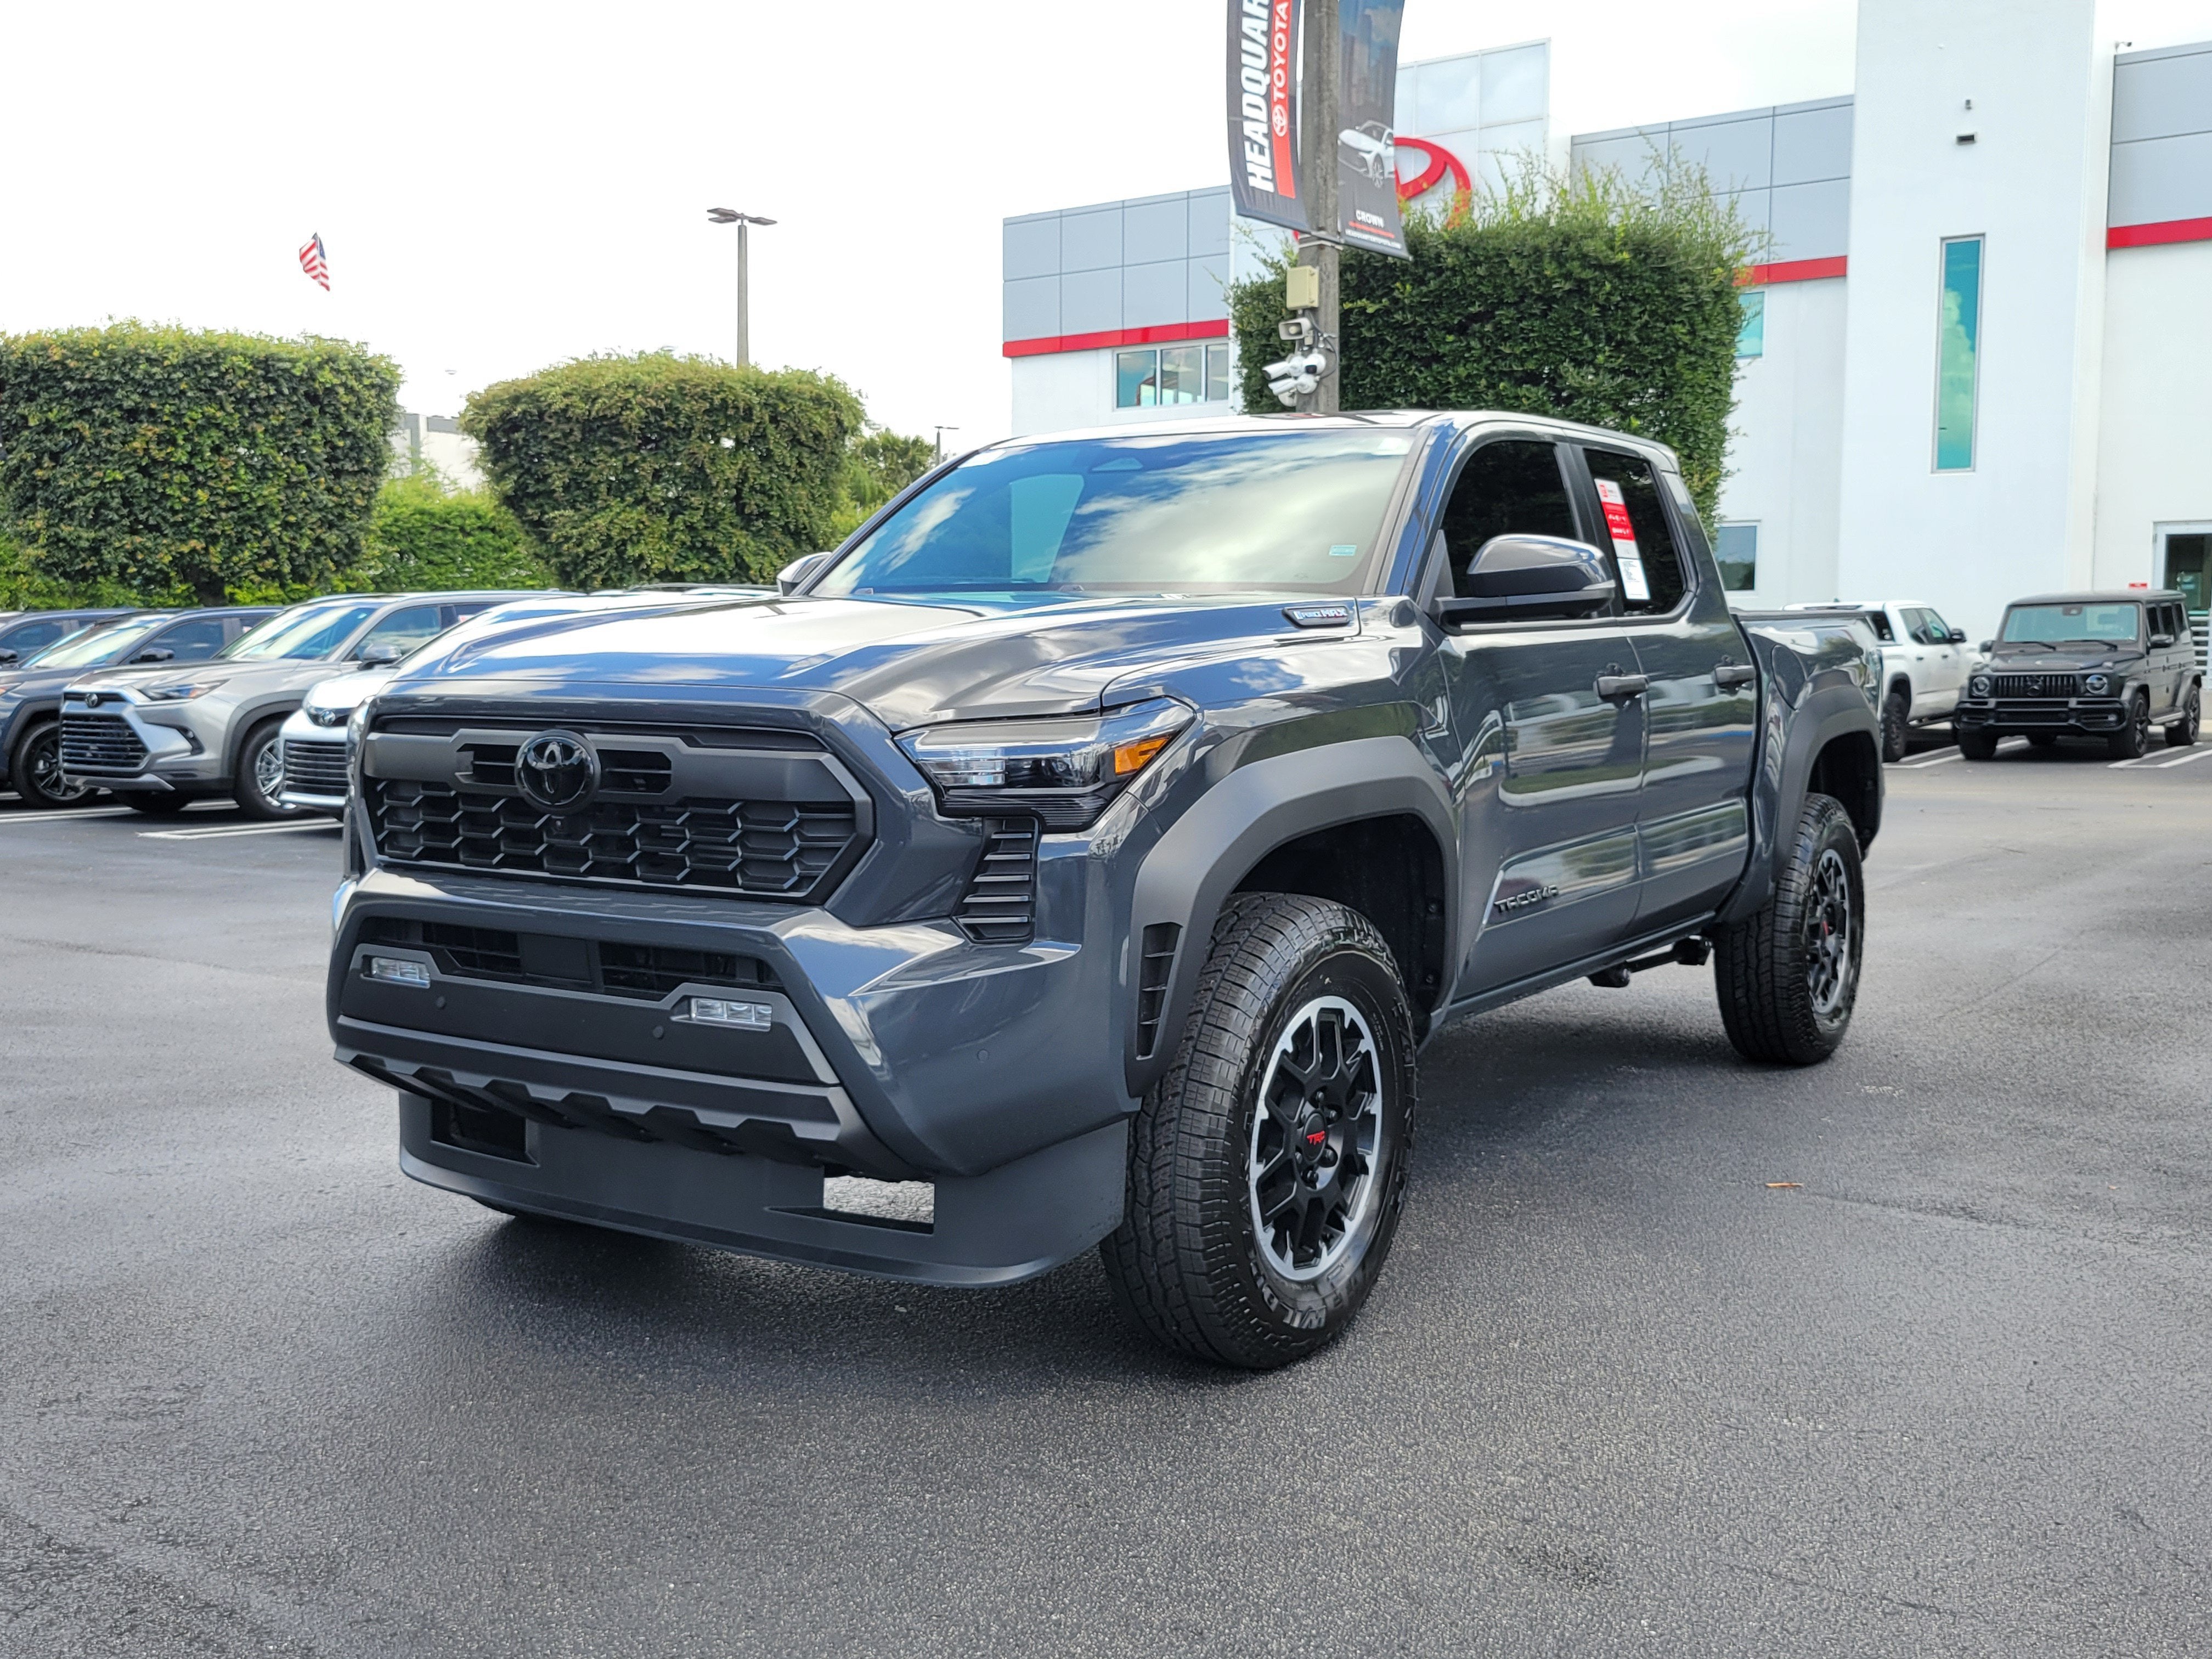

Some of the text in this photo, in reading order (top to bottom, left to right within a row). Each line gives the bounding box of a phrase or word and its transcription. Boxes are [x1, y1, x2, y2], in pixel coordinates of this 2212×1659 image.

[1273, 1, 1289, 103] TOYOTA
[1356, 209, 1384, 228] CROWN
[1494, 885, 1559, 912] TACOMA
